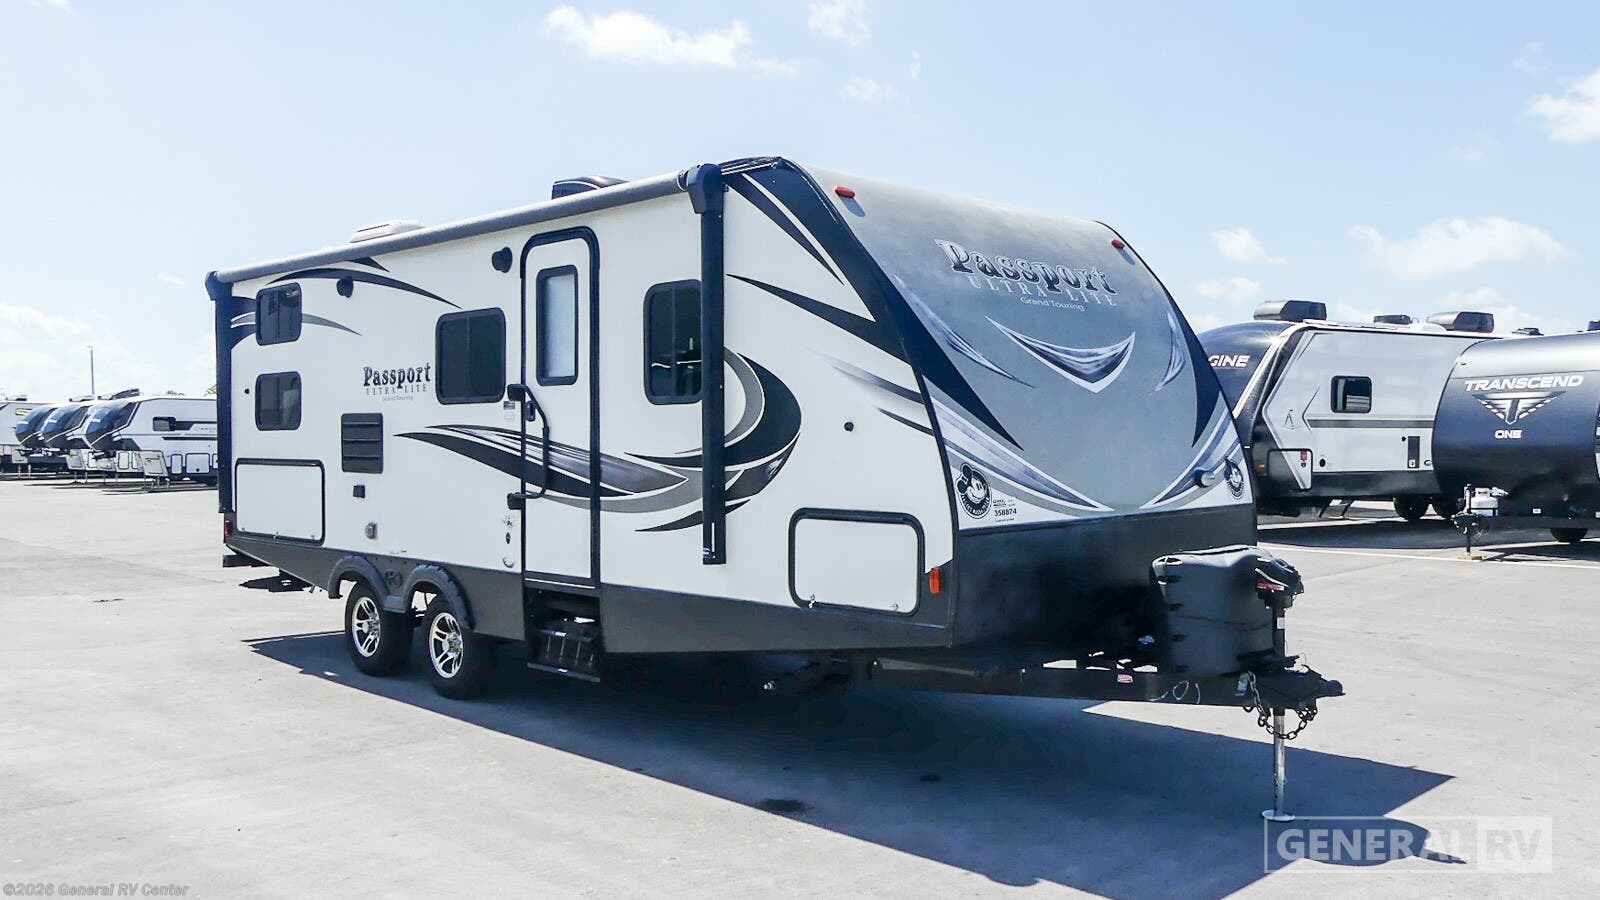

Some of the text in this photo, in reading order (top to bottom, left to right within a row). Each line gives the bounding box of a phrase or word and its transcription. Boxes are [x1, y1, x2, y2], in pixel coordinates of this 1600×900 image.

[934, 239, 1117, 295] Passport
[968, 275, 1117, 307] ULTRA LITE
[1020, 297, 1085, 312] Grand Touring
[363, 362, 431, 389] Passport
[1464, 375, 1584, 392] TRANSCEND
[404, 383, 427, 393] LITE
[1494, 429, 1522, 439] ONE
